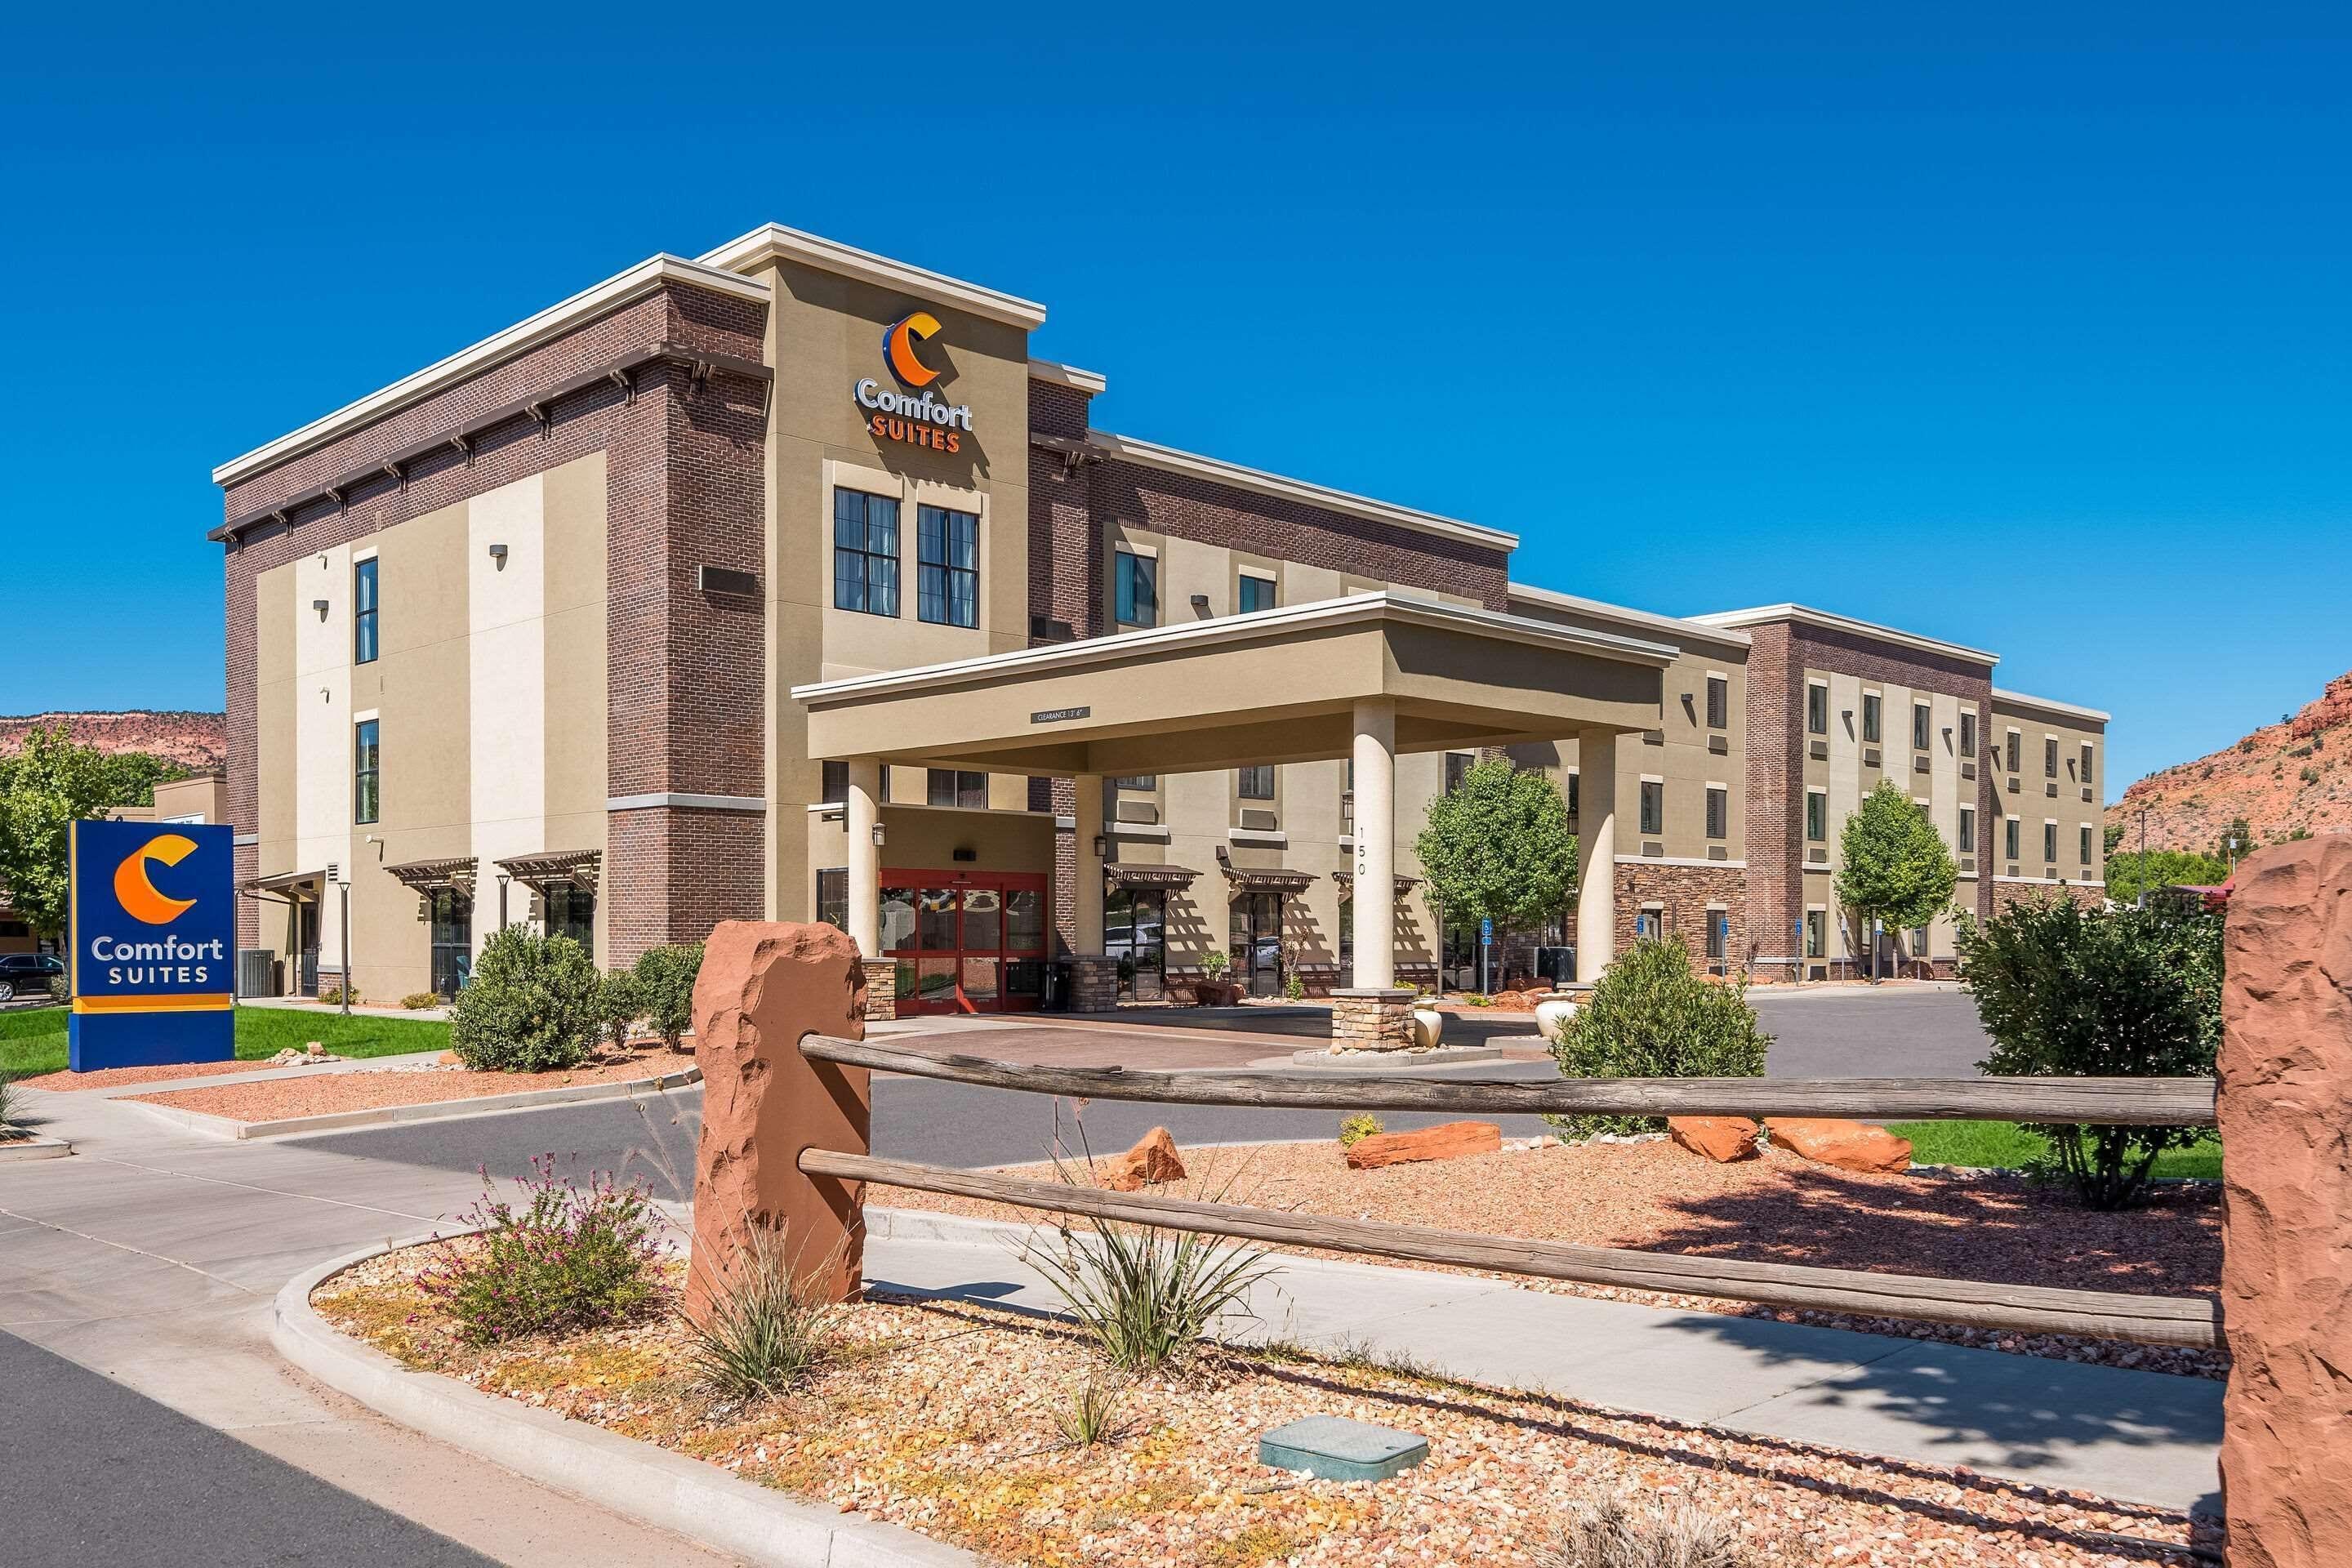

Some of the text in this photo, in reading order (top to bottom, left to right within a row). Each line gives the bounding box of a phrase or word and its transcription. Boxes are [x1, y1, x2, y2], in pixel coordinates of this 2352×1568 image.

[855, 377, 973, 431] Comfort
[871, 415, 960, 453] SUITES
[1037, 711, 1067, 721] CLEARANCE
[91, 934, 223, 961] Comfort
[108, 965, 208, 984] SUITES
